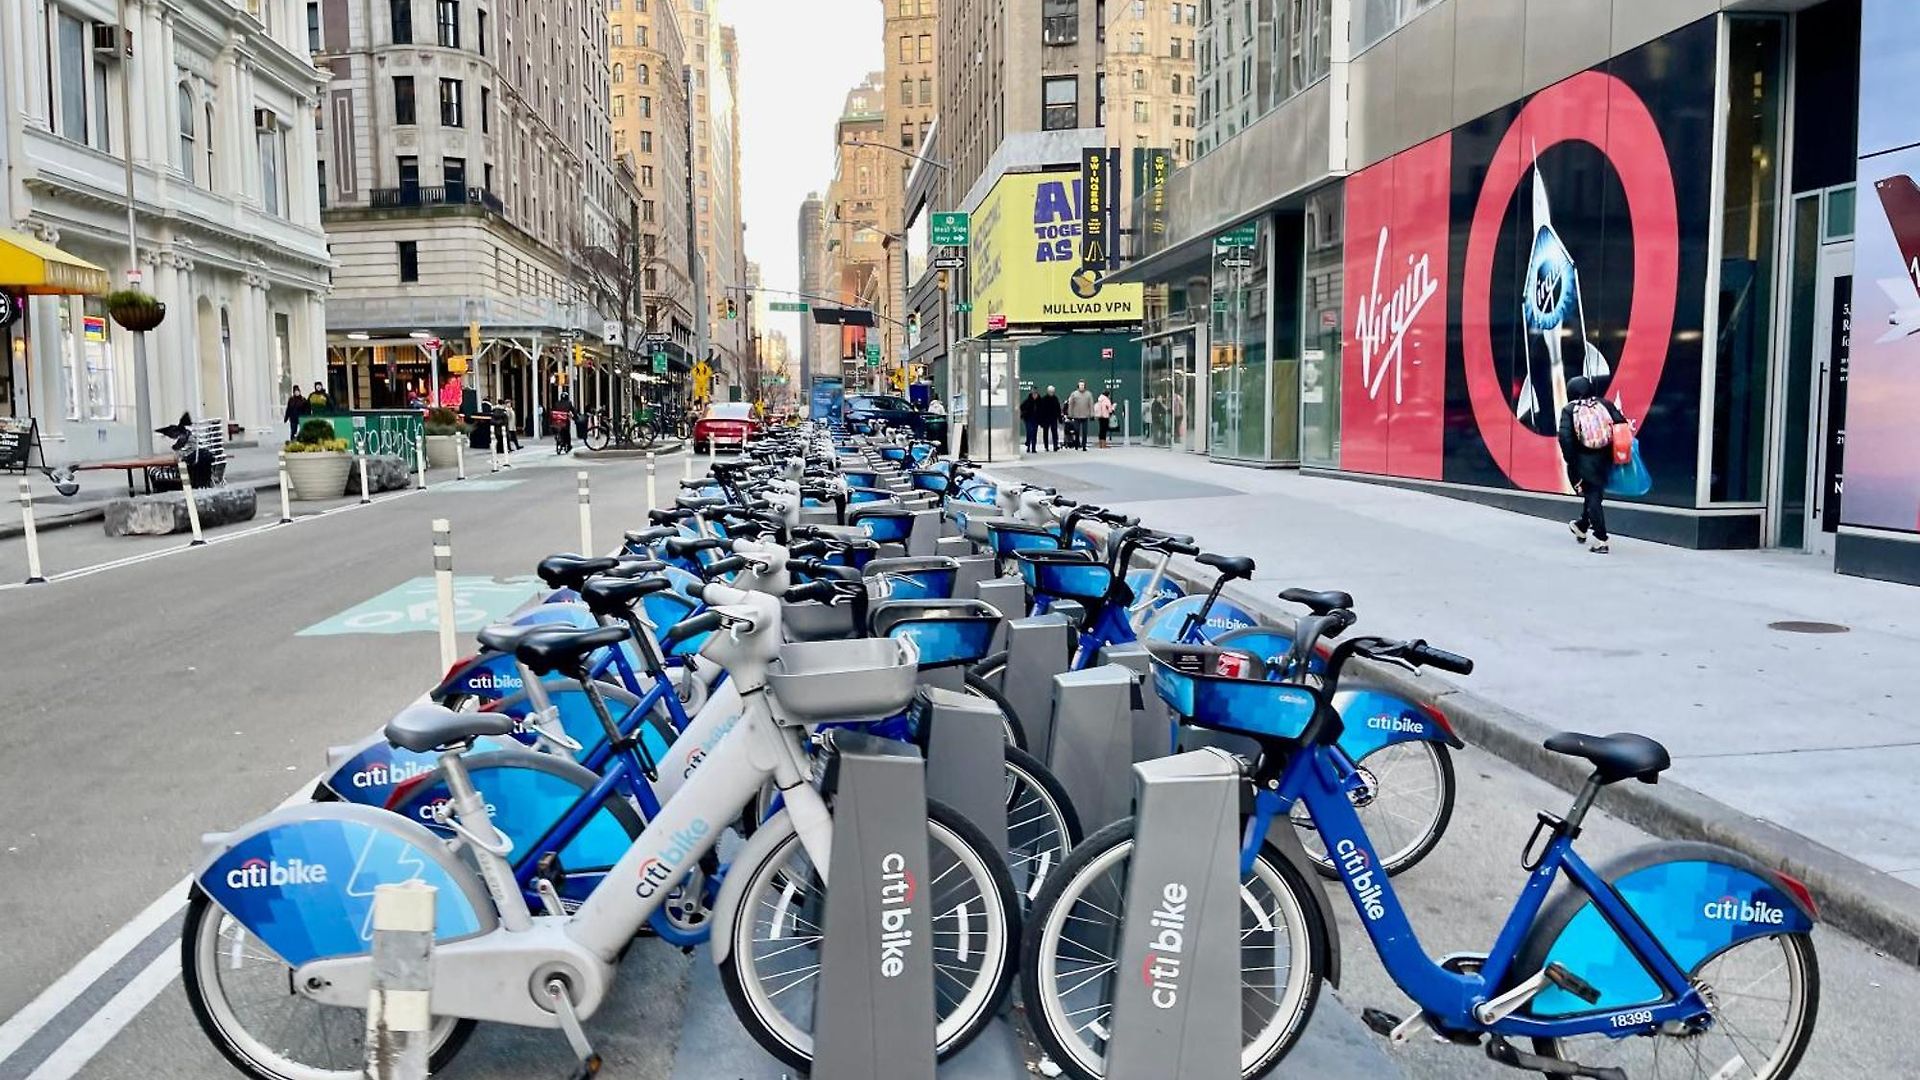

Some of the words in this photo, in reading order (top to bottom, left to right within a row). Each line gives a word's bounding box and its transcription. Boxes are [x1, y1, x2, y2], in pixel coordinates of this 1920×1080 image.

[1090, 156, 1099, 212] SWINGERS
[1035, 224, 1081, 239] TOGE
[1036, 239, 1073, 262] AS
[1043, 303, 1101, 314] MULLVAD
[1102, 302, 1131, 312] VPN
[1355, 226, 1438, 404] Virgin
[1610, 1011, 1652, 1028] 18399
